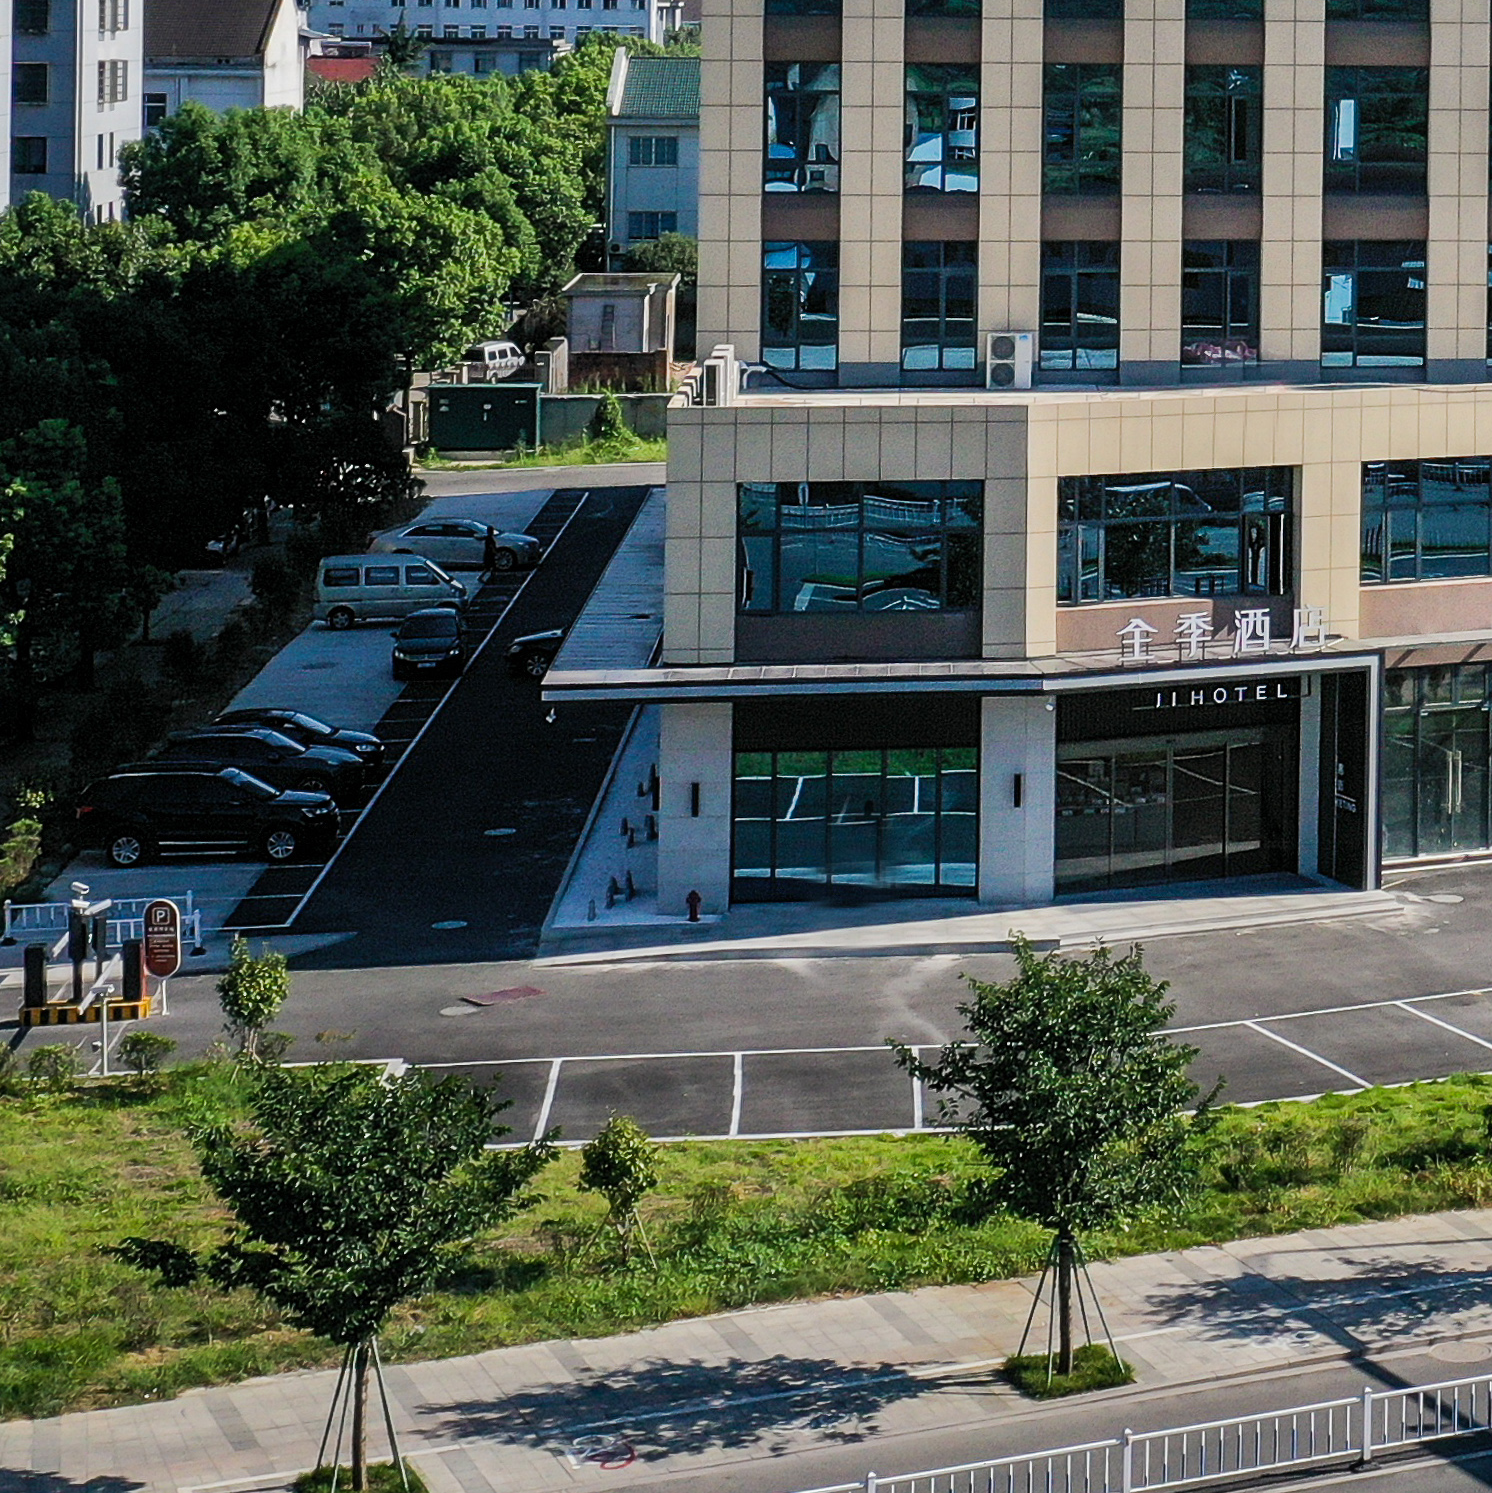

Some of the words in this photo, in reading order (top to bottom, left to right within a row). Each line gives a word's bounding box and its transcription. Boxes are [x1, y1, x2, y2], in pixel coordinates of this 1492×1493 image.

[1116, 605, 1328, 661] 全季酒店
[1190, 684, 1288, 706] HOTEL
